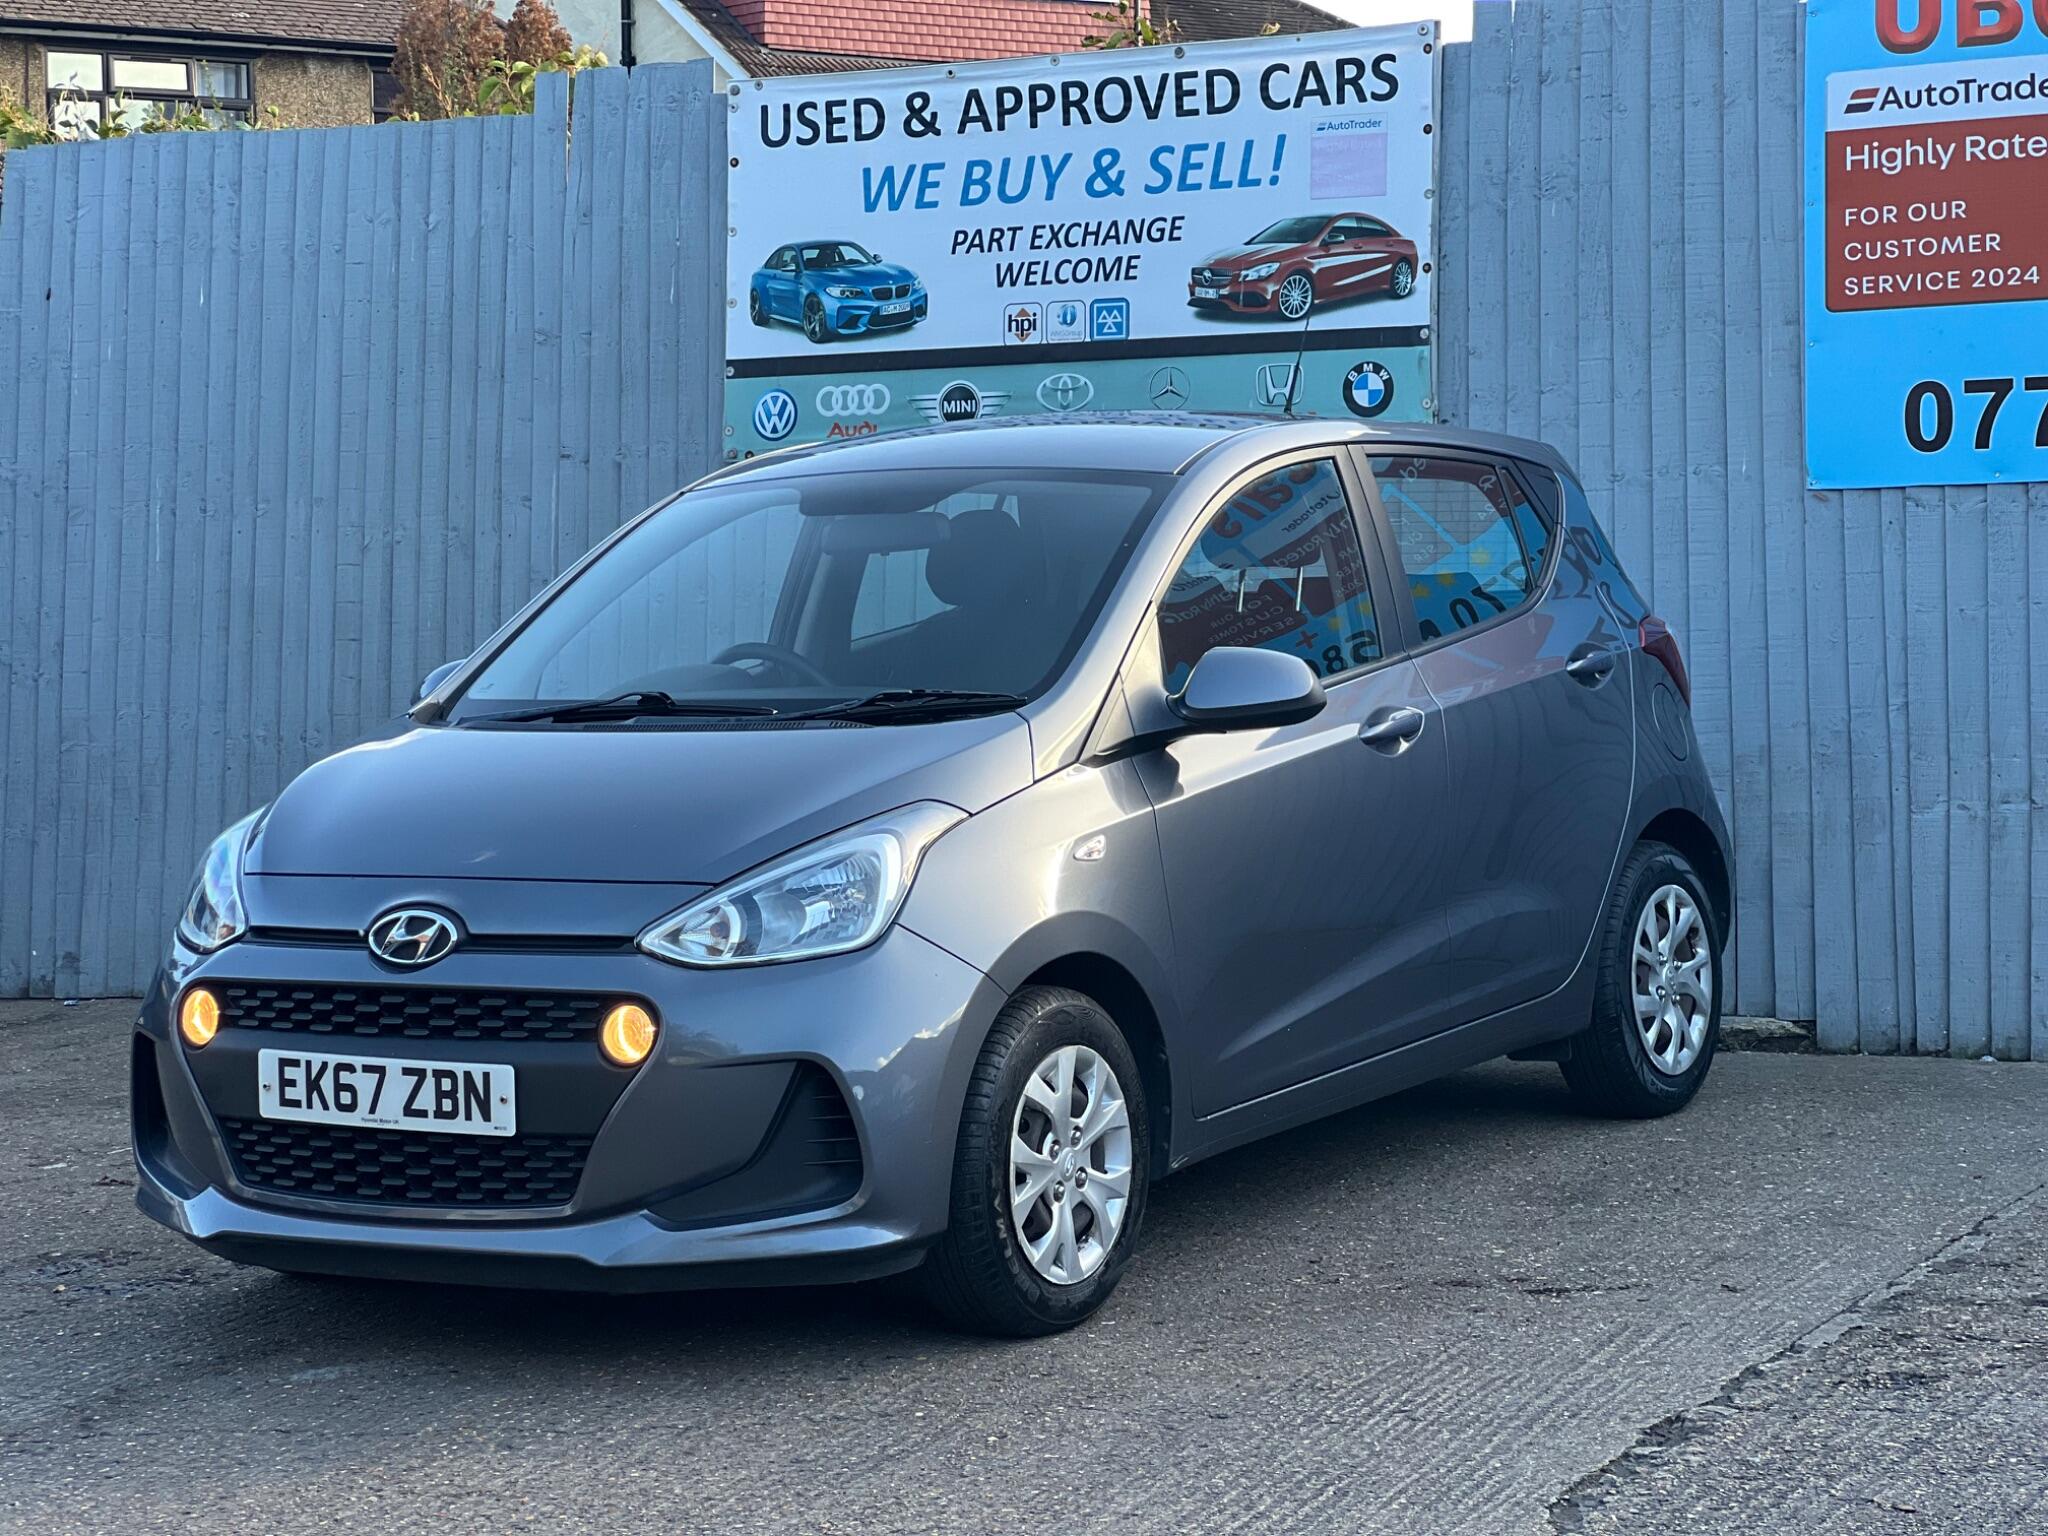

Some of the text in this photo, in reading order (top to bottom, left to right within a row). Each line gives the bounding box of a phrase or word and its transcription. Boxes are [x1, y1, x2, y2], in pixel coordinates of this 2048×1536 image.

[760, 53, 1399, 149] USED & APPROVED CARS
[1327, 119, 1382, 131] AutoTrader
[1846, 137, 1956, 175] Highly
[862, 161, 946, 213] WE
[959, 152, 1074, 207] BUY
[1084, 147, 1127, 199] &
[1143, 133, 1287, 195] SELL!
[1845, 200, 1967, 227] FOR OUR
[950, 215, 1186, 255] PART EXCHANGE
[1844, 233, 2001, 261] CUSTOMER
[995, 254, 1141, 288] WELCOME
[1844, 265, 2040, 296] SERVICE 2024
[1007, 311, 1037, 338] hpi
[943, 400, 976, 414] MINI
[277, 1056, 492, 1123] EK67 ZBN
